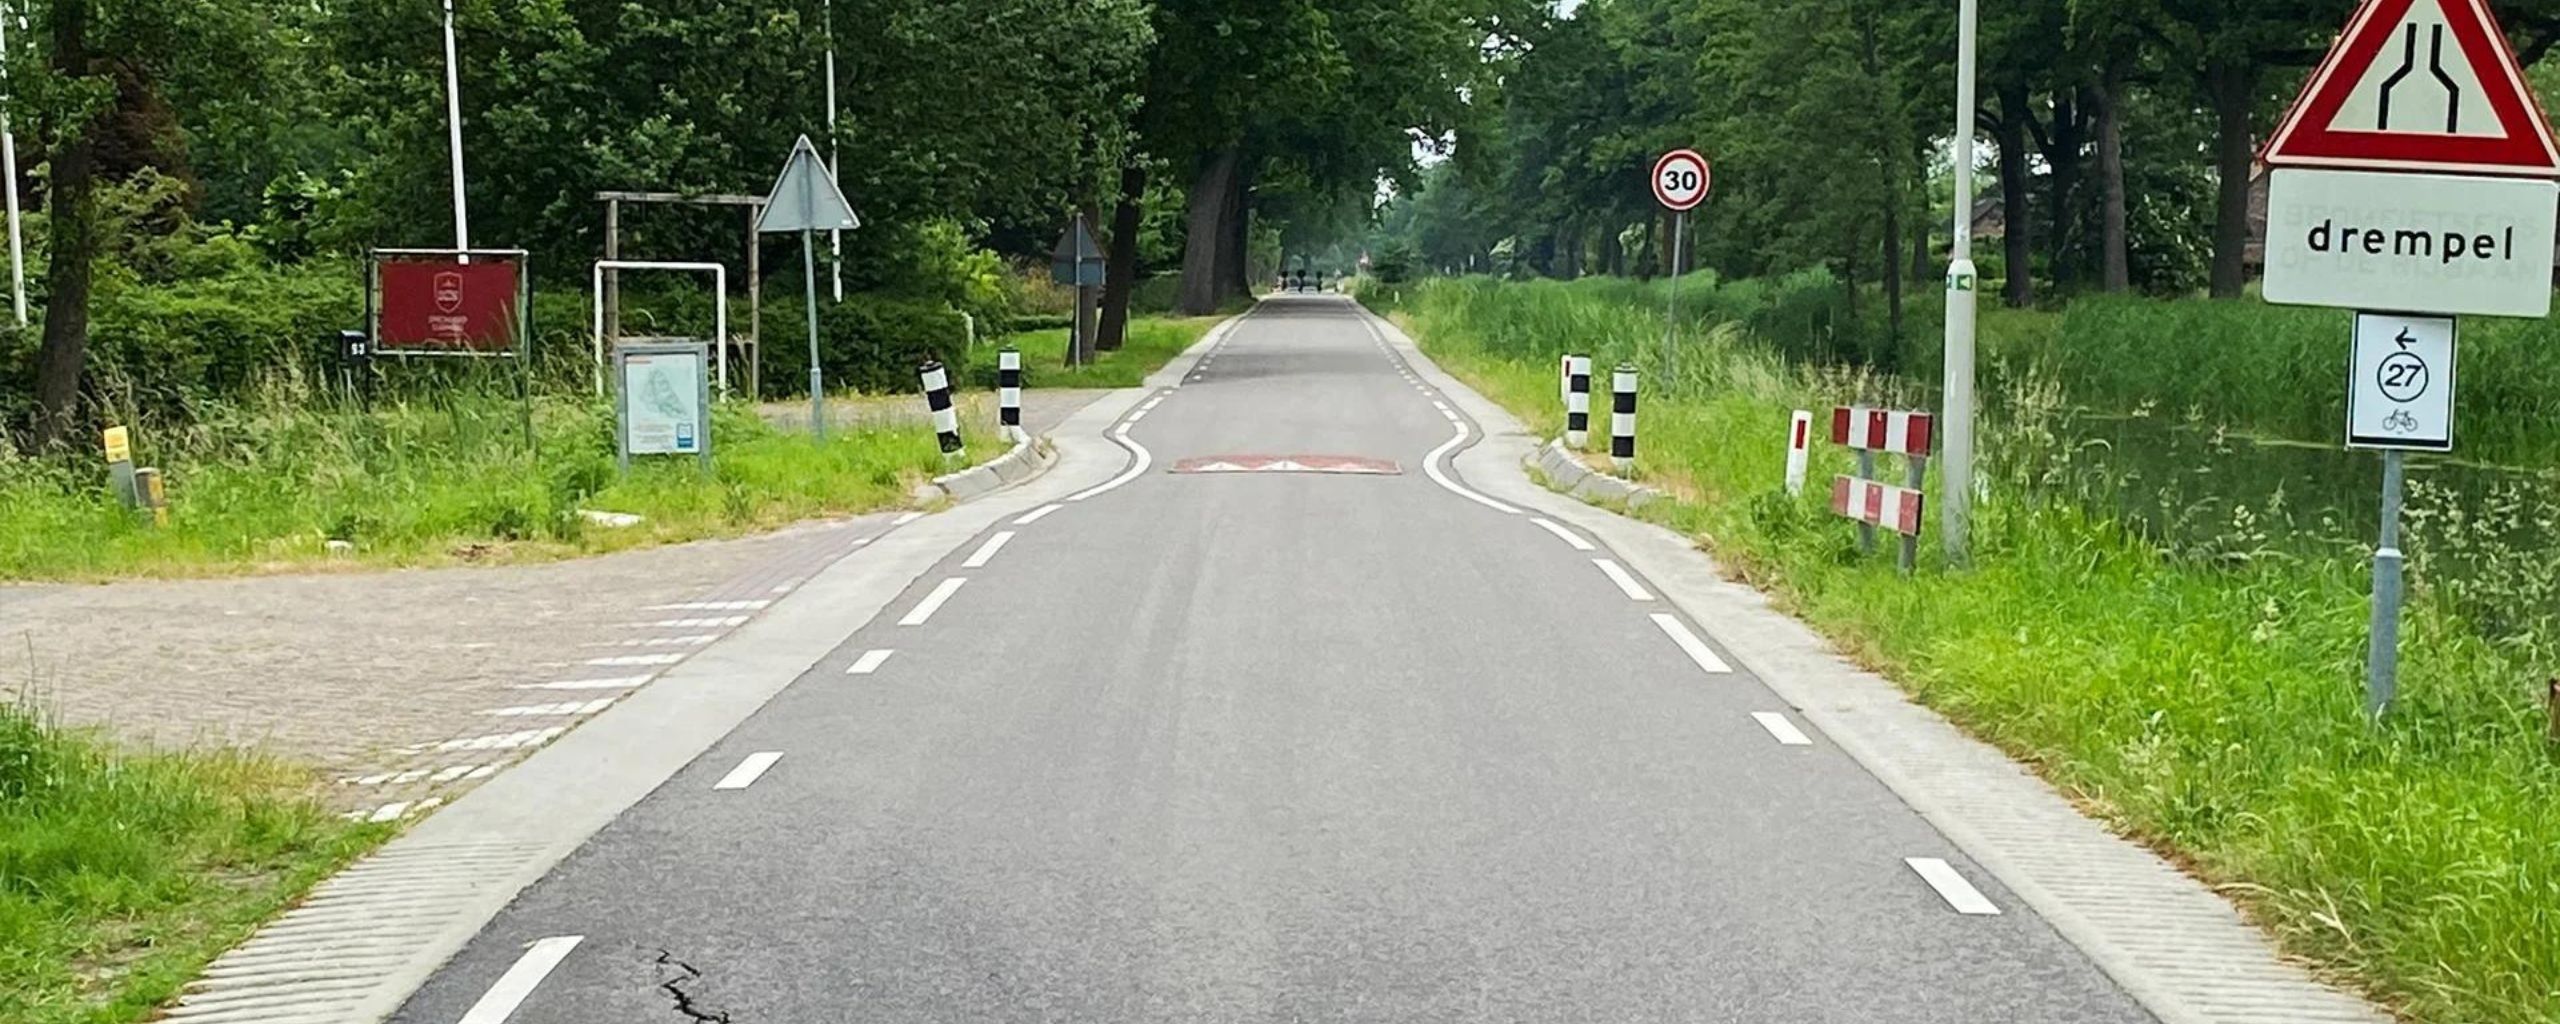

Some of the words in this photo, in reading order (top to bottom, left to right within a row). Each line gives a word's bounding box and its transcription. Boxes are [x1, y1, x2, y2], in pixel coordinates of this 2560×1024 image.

[1664, 170, 1697, 191] 30
[2307, 218, 2513, 264] drempel
[2384, 363, 2423, 387] 27
